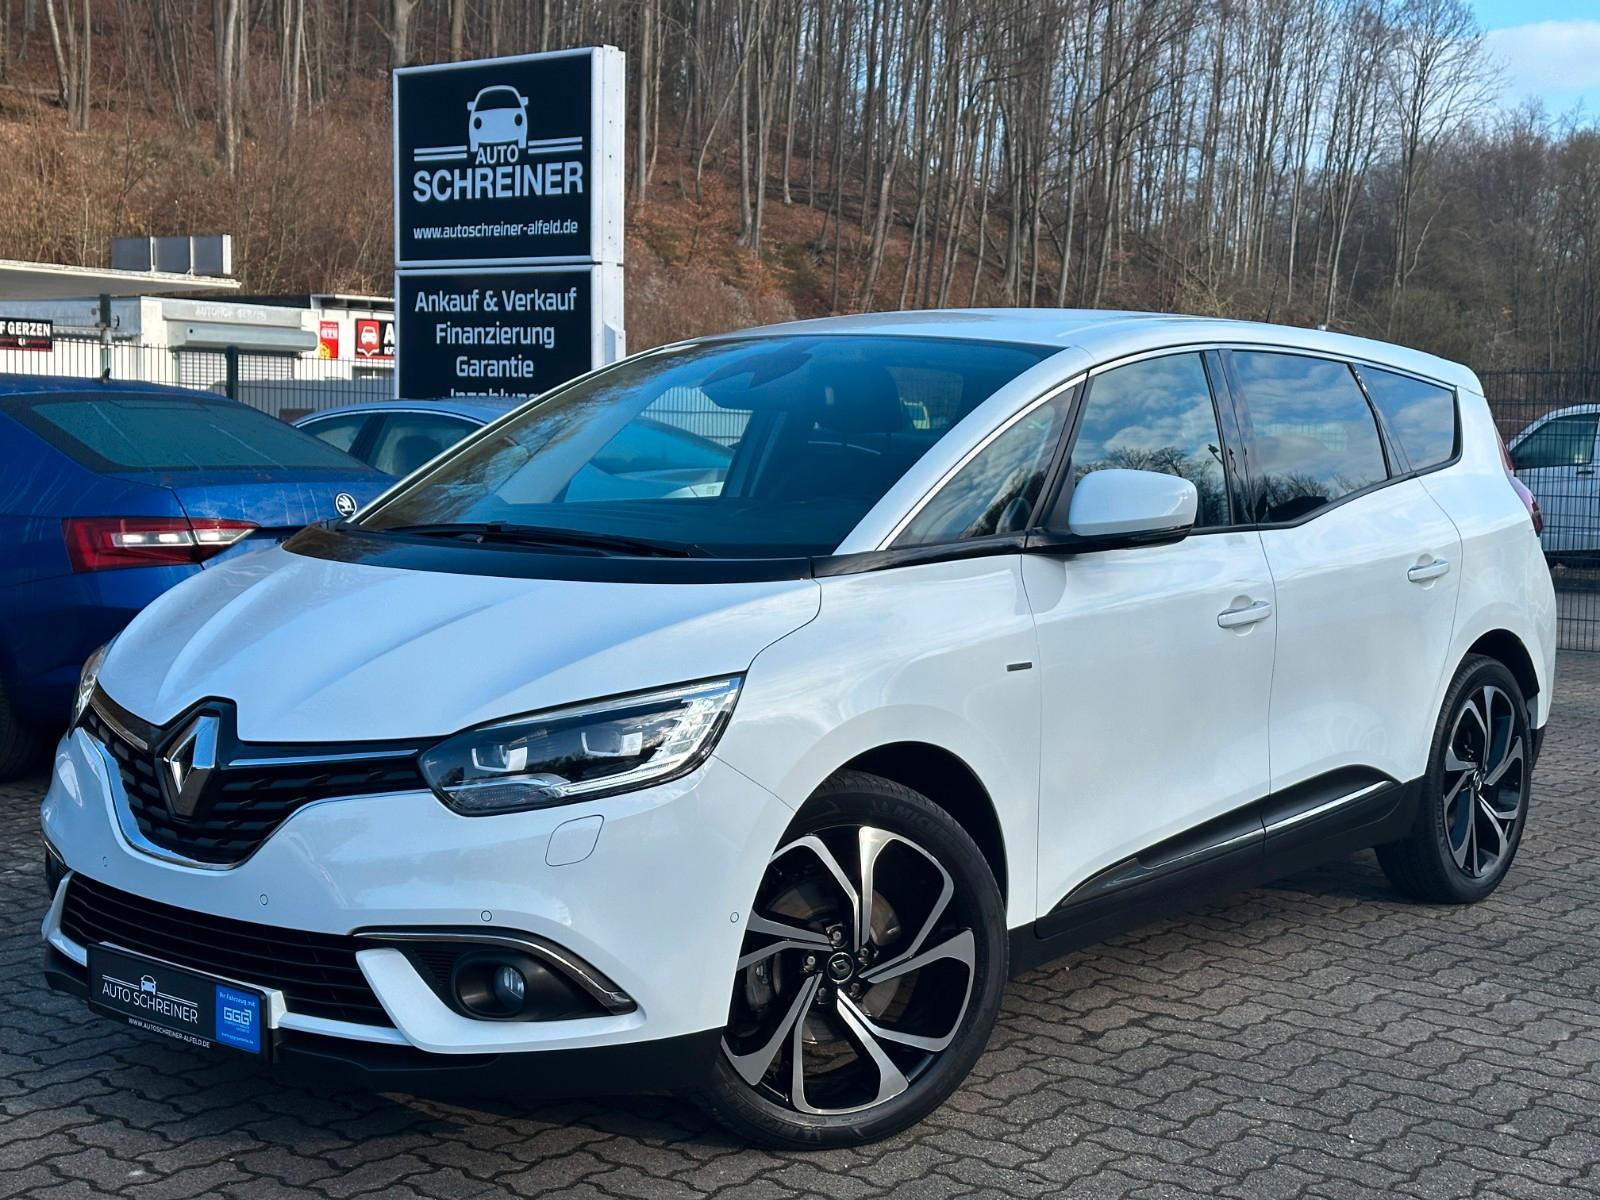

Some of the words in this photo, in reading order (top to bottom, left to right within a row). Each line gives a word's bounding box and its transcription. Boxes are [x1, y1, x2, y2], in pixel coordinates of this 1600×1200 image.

[475, 144, 519, 165] AUTO
[413, 161, 583, 201] SCHREINER
[413, 219, 578, 239] www.autoschreiner-alfeld.de
[414, 289, 479, 312] Ankauf
[483, 290, 499, 312] &
[501, 287, 577, 311] Verkauf
[7, 321, 51, 337] GERZEN
[435, 321, 555, 349] Finanzierung
[455, 354, 535, 378] Garantie
[102, 982, 131, 1002] AUTO
[132, 991, 199, 1025] SCHREINER
[223, 1006, 252, 1026] GGG
[128, 1017, 210, 1049] WWW.AUTOSCHREINER-ALFELD.DE
